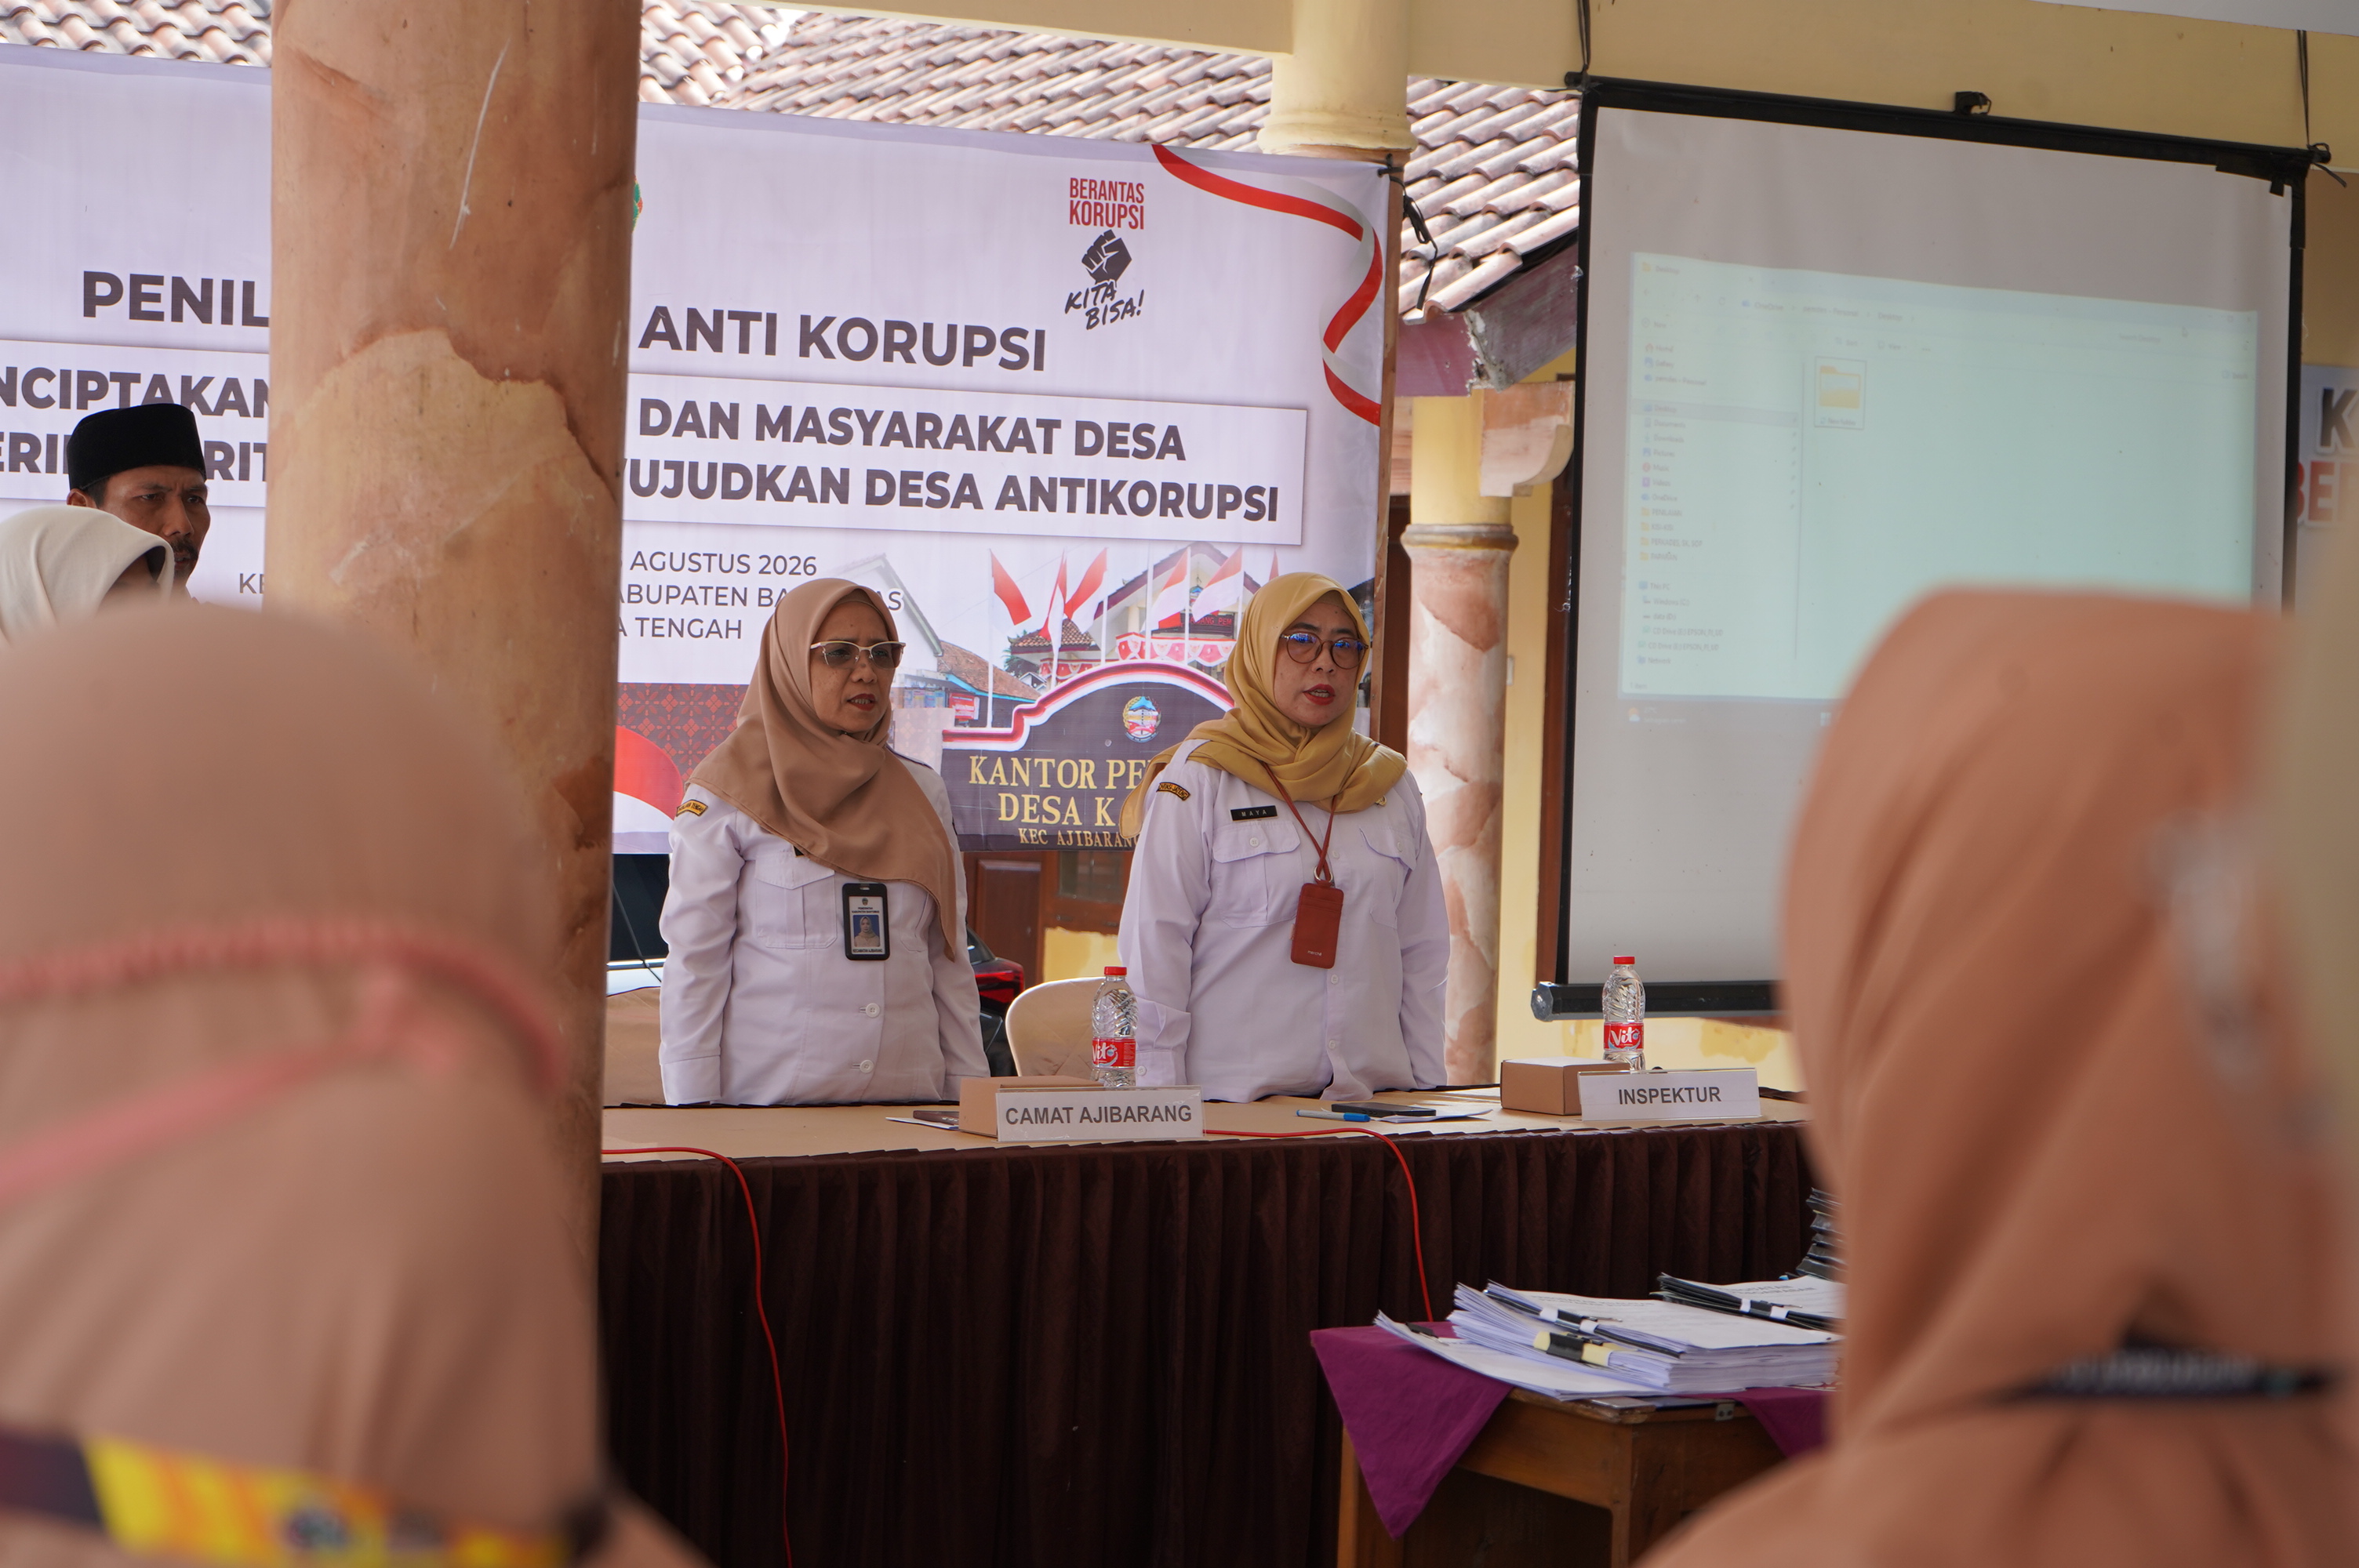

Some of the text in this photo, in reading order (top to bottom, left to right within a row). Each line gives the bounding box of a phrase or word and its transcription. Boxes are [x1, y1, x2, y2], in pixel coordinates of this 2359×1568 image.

[1069, 177, 1144, 204] BERANTAS
[1069, 200, 1144, 230] KORUPSI
[1065, 280, 1117, 314] KITA
[1085, 289, 1144, 330] BISA!
[638, 306, 776, 355] ANTI
[799, 315, 1045, 371] KORUPSI
[640, 398, 739, 440] DAN
[756, 405, 1061, 454] MASYARAKAT
[1075, 420, 1186, 460] DESA
[624, 459, 1278, 521] UJUDKAN DESA ANTIKORUPSI
[630, 551, 817, 576] AGUSTUS 2026
[620, 584, 747, 607] BUPATEN
[635, 618, 742, 639] TENGAH
[969, 756, 1150, 789] KANTOR PE
[998, 793, 1082, 826] DESA
[1018, 828, 1048, 845] KEC
[1619, 1086, 1721, 1105] INSPEKTUR
[1005, 1105, 1192, 1125] CAMAT AJIBARANG
